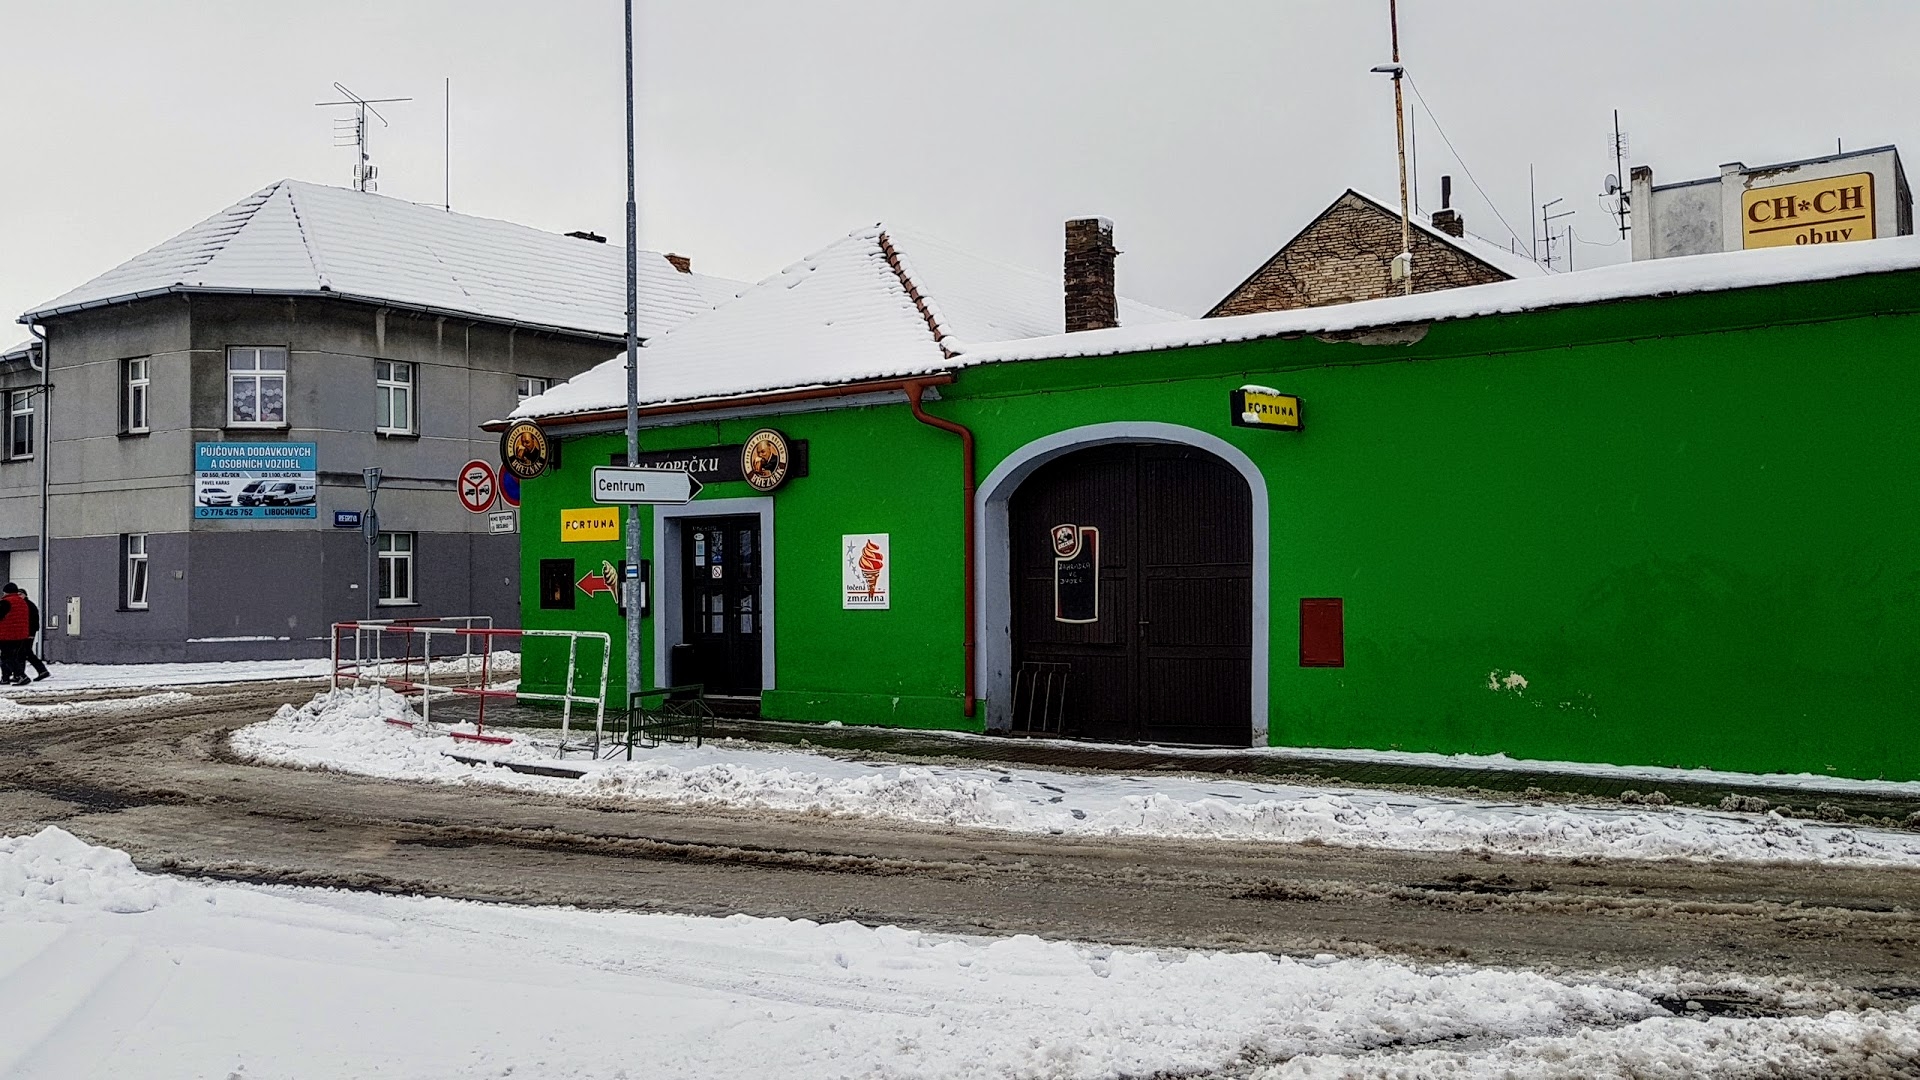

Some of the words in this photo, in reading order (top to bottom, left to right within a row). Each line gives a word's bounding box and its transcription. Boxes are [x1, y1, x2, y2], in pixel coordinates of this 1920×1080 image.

[1795, 228, 1853, 245] obuv
[1248, 402, 1294, 417] FORTUNA
[200, 445, 246, 457] PŮJČOVNA
[247, 445, 311, 457] DODÁVKOVÝCH
[210, 459, 217, 469] A
[220, 458, 263, 469] OSOBNÍCH
[265, 459, 301, 469] VOZIDEL
[599, 479, 645, 492] Centrum
[240, 508, 253, 516] 752
[264, 508, 311, 516] LIBOCHOVICE
[565, 519, 615, 530] FORTUNA
[846, 593, 885, 602] zmrzlina
